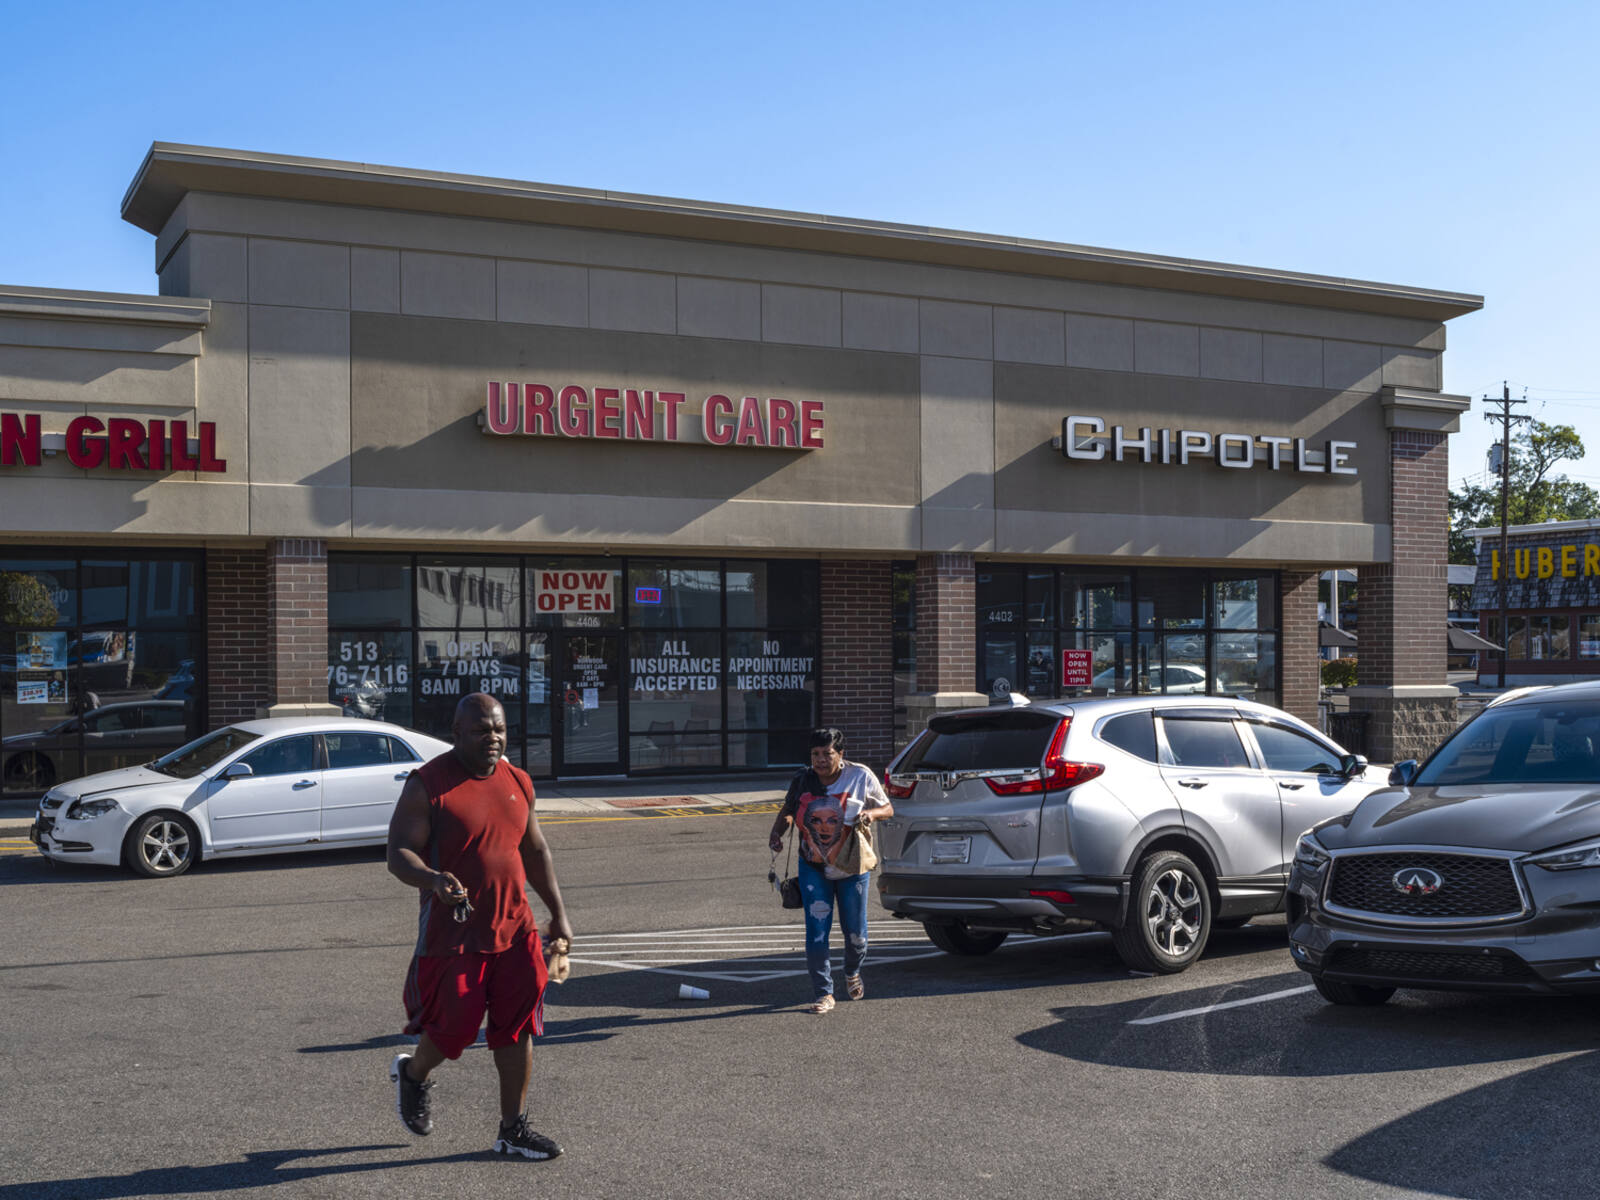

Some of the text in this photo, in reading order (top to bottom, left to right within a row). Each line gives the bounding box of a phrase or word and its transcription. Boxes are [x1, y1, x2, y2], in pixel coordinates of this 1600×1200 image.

[486, 380, 825, 449] URGENT CARE
[0, 413, 227, 473] N GRILL
[1062, 415, 1358, 475] CHIPOTLE
[542, 572, 607, 590] NOW
[537, 593, 611, 611] OPEN
[637, 589, 660, 601] OPEN
[989, 610, 1013, 622] 4402
[340, 641, 378, 661] 513
[447, 641, 493, 657] OPEN
[662, 640, 690, 656] ALL
[763, 640, 780, 656] NO
[440, 660, 500, 676] 7 DAYS
[630, 658, 721, 674] INSURANCE
[728, 657, 813, 673] APPOINTMENT
[421, 678, 460, 695] 8AM
[480, 678, 518, 694] 8PM
[634, 675, 718, 691] ACCEPTED
[737, 675, 806, 690] NECESSARY
